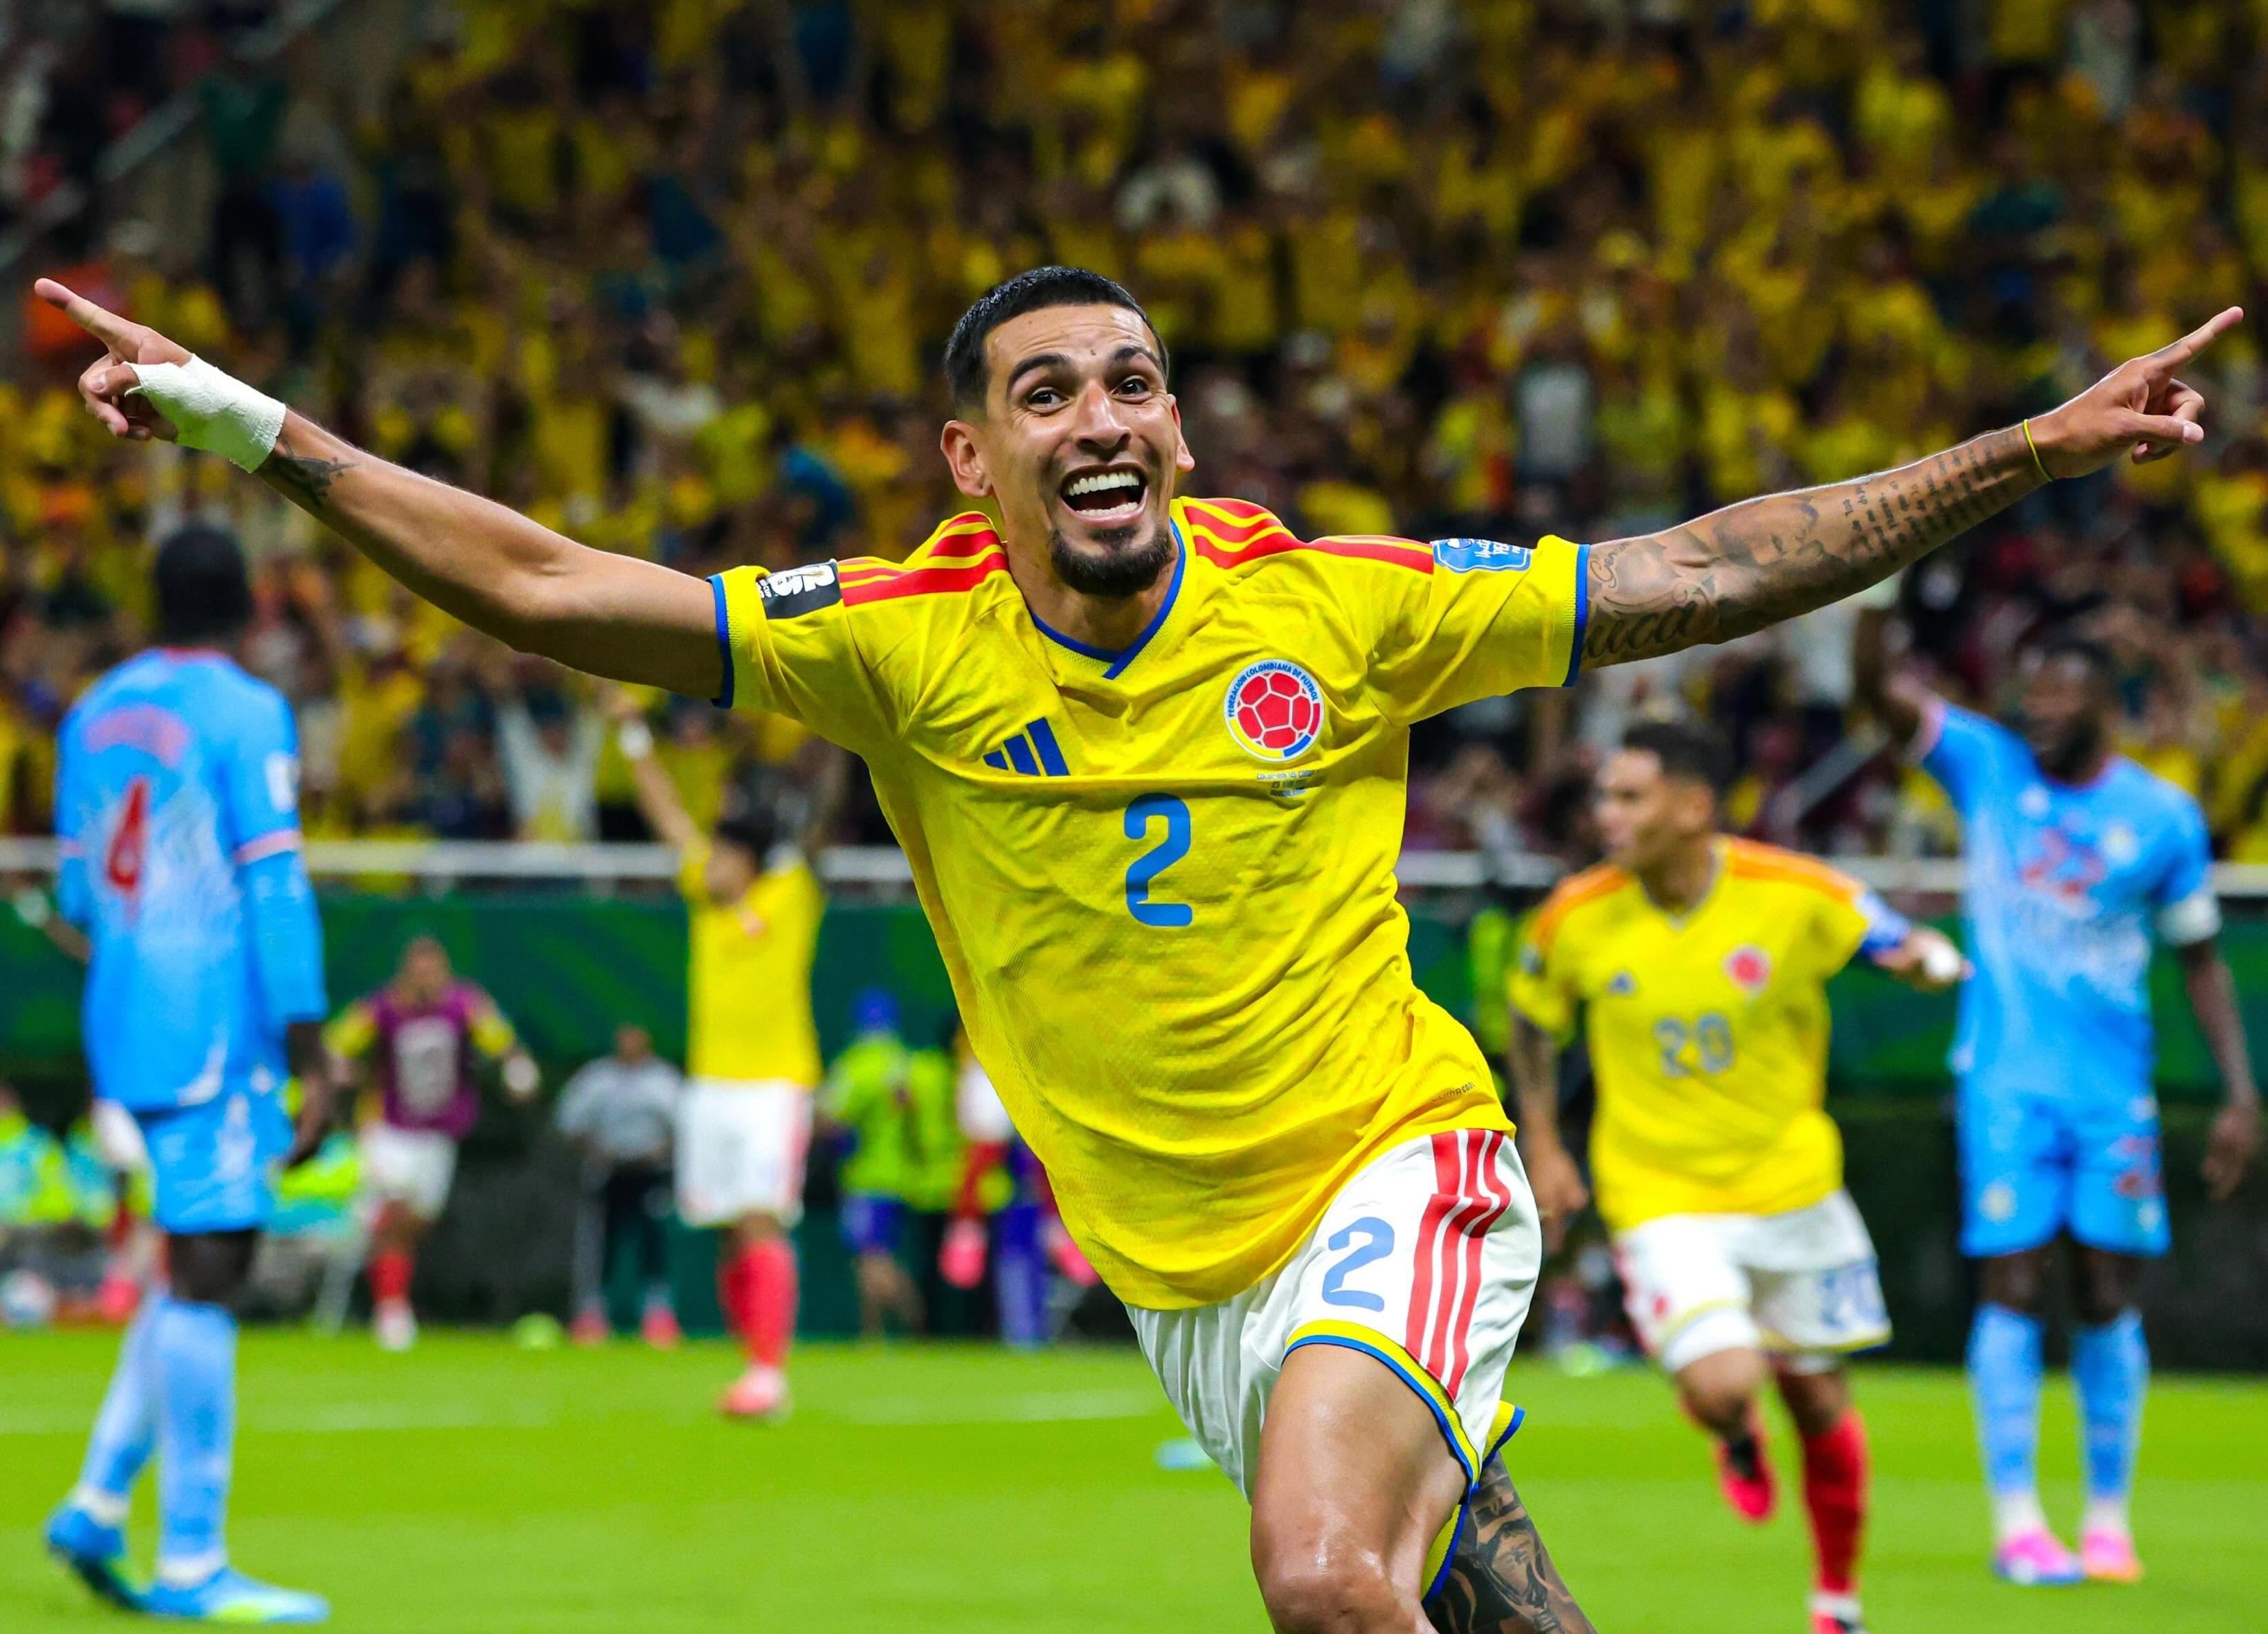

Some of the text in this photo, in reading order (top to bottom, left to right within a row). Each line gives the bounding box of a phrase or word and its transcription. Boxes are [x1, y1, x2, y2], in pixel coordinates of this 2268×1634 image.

[1228, 662, 1318, 718] FEDERACION COLOMBIANA DE FUTBOL
[1124, 792, 1192, 927] 2
[1651, 1012, 1736, 1078] 20
[1322, 1217, 1395, 1312] 2
